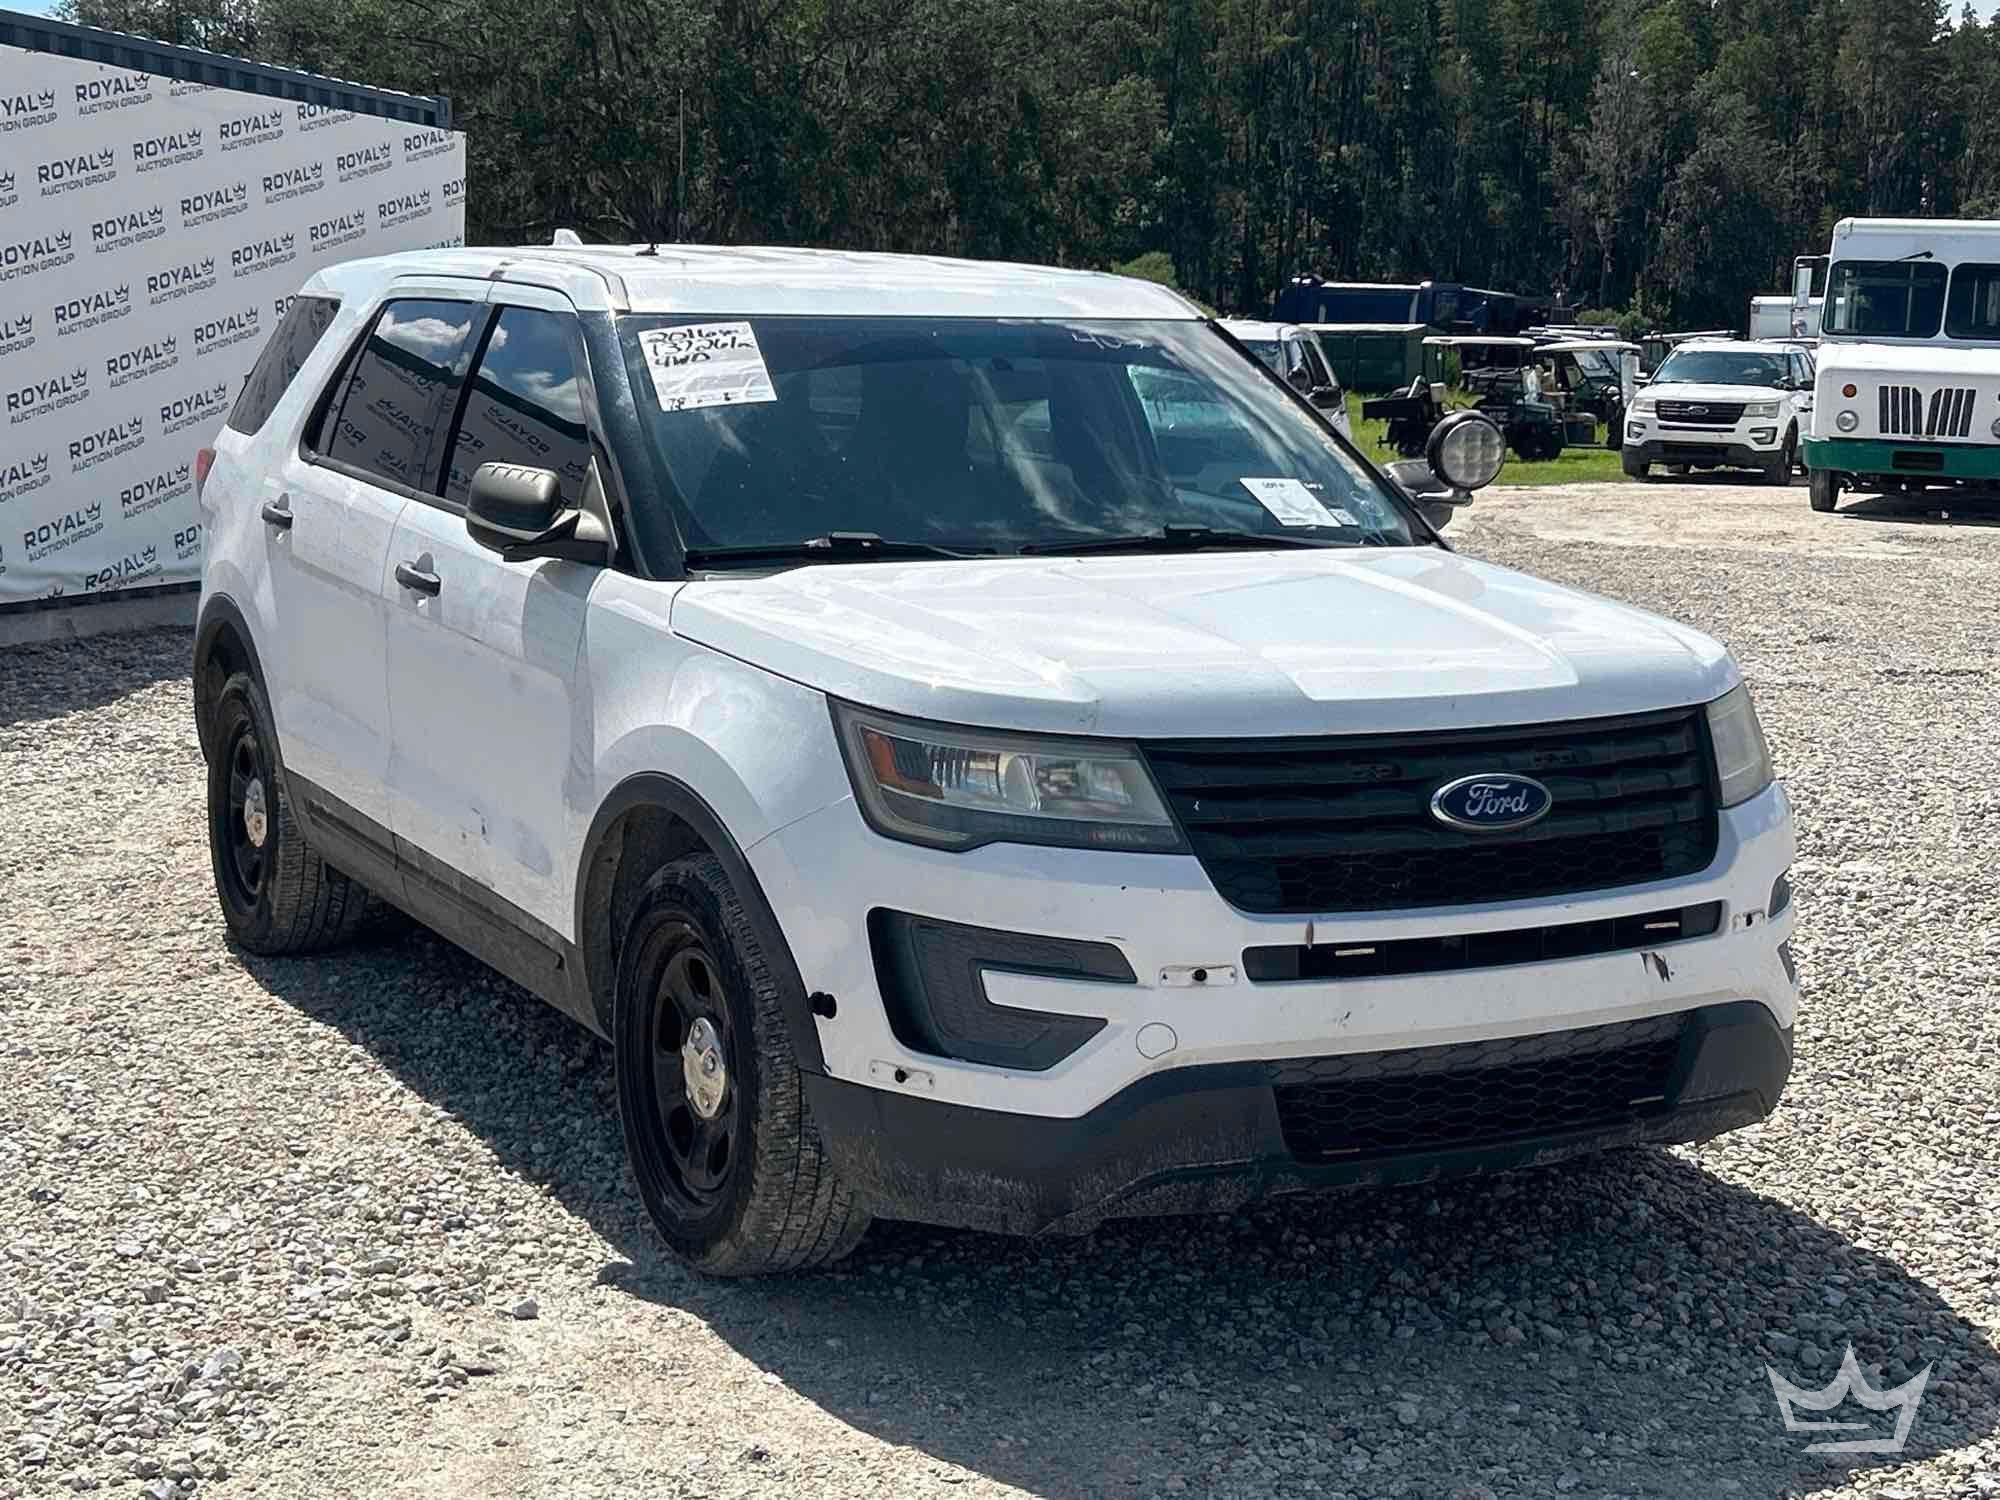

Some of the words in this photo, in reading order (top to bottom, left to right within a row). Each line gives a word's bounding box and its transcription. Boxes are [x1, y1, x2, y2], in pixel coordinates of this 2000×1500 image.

[75, 76, 135, 102] ROYAL
[0, 94, 39, 116] YAL
[79, 99, 119, 116] AUCTION
[220, 115, 270, 139] ROYAL
[133, 134, 187, 160] ROYAL
[404, 130, 444, 152] ROYAL
[38, 154, 99, 183] ROYAL
[136, 157, 173, 172] AUCTION
[337, 147, 380, 171] ROYAL
[41, 179, 83, 197] AUCTION
[263, 167, 310, 192] ROYAL
[443, 178, 465, 198] ROY
[181, 188, 233, 216] ROYAL
[378, 194, 420, 218] ROYAL
[92, 212, 149, 240] ROYAL
[310, 216, 354, 240] ROYAL
[0, 238, 56, 267] OYAL
[96, 236, 133, 253] AUCTION
[232, 238, 282, 266] ROYAL
[0, 262, 39, 281] UCTION
[147, 264, 202, 293] ROYAL
[55, 291, 115, 323] ROYAL
[150, 286, 187, 305] AUCTION
[58, 316, 99, 336] AUCTION
[194, 314, 245, 344] ROYAL
[196, 337, 232, 356] AUCTION
[107, 344, 162, 376] ROYAL
[110, 368, 148, 388] AUCTION
[7, 376, 72, 412] ROYAL
[11, 401, 54, 424] AUCTION
[161, 391, 214, 423] ROYAL
[163, 416, 200, 436] AUCTION
[69, 424, 128, 460] ROYAL
[72, 449, 113, 474] AUCTION
[121, 472, 176, 507] ROYAL
[124, 497, 161, 519] AUCTION
[24, 512, 86, 549] ROYAL
[29, 538, 69, 562] AUCTION
[85, 554, 144, 591] ROYAL
[1465, 783, 1529, 816] Ford
